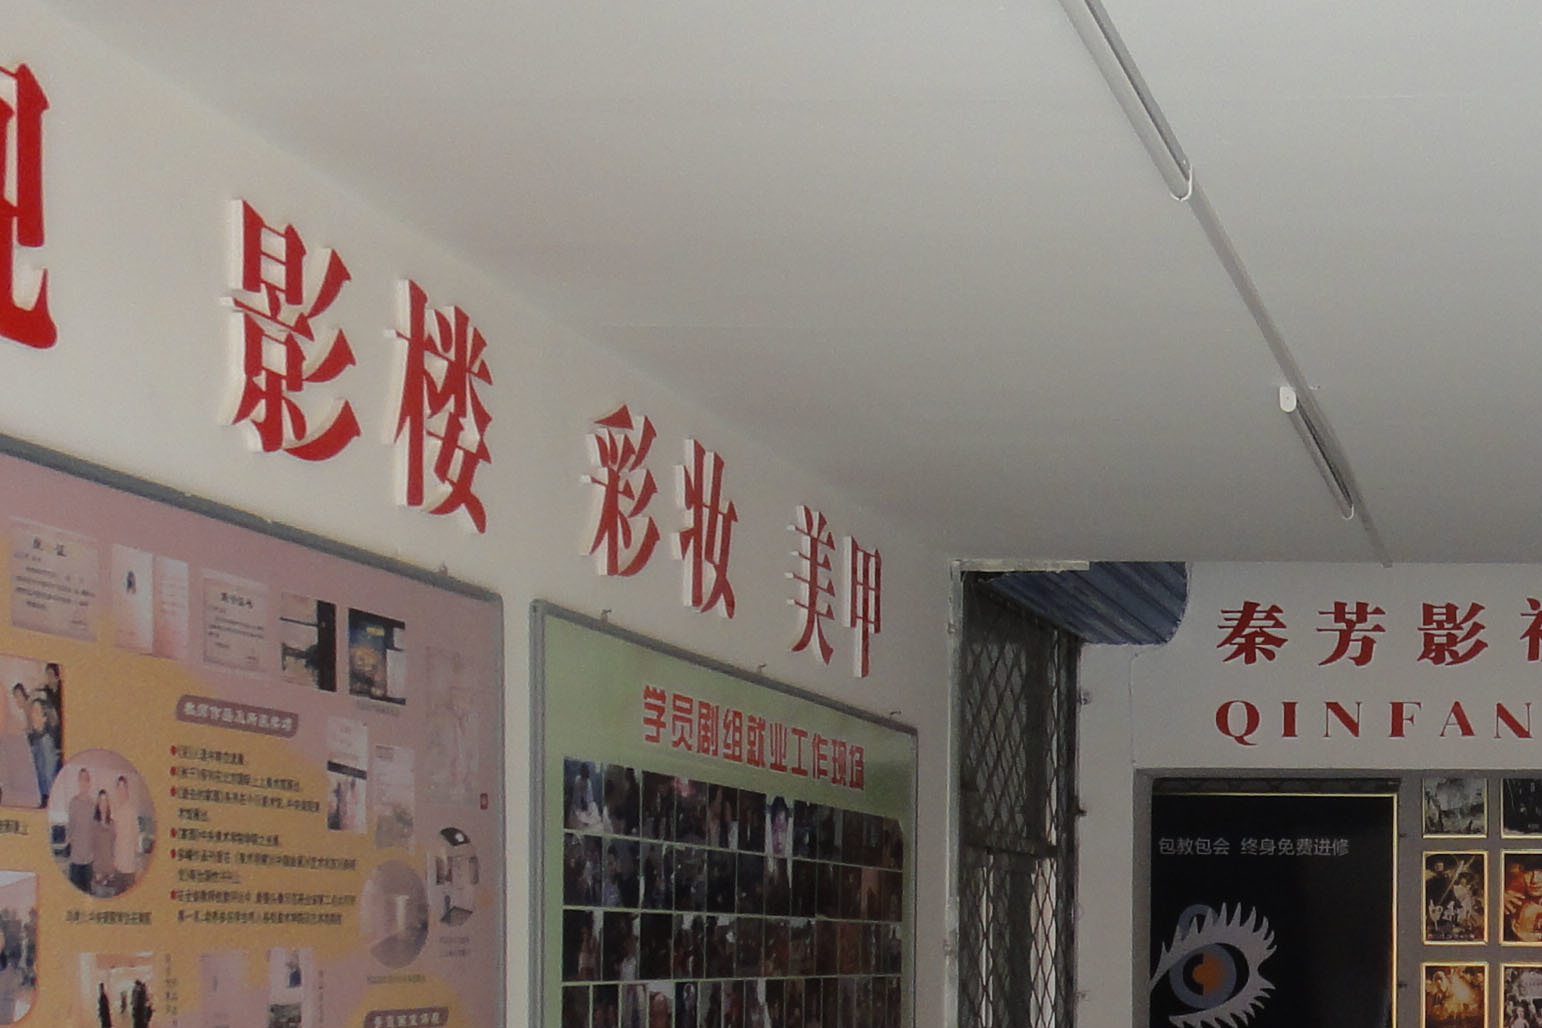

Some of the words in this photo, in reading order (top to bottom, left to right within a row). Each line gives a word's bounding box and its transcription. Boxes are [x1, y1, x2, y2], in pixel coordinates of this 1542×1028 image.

[226, 199, 494, 533] 影楼
[587, 404, 740, 619] 彩妆
[790, 505, 883, 678] 美甲
[642, 685, 866, 791] 学员剧组就业工作现场
[1157, 836, 1231, 856] 包教包会
[1240, 836, 1350, 857] 终身免费进修
